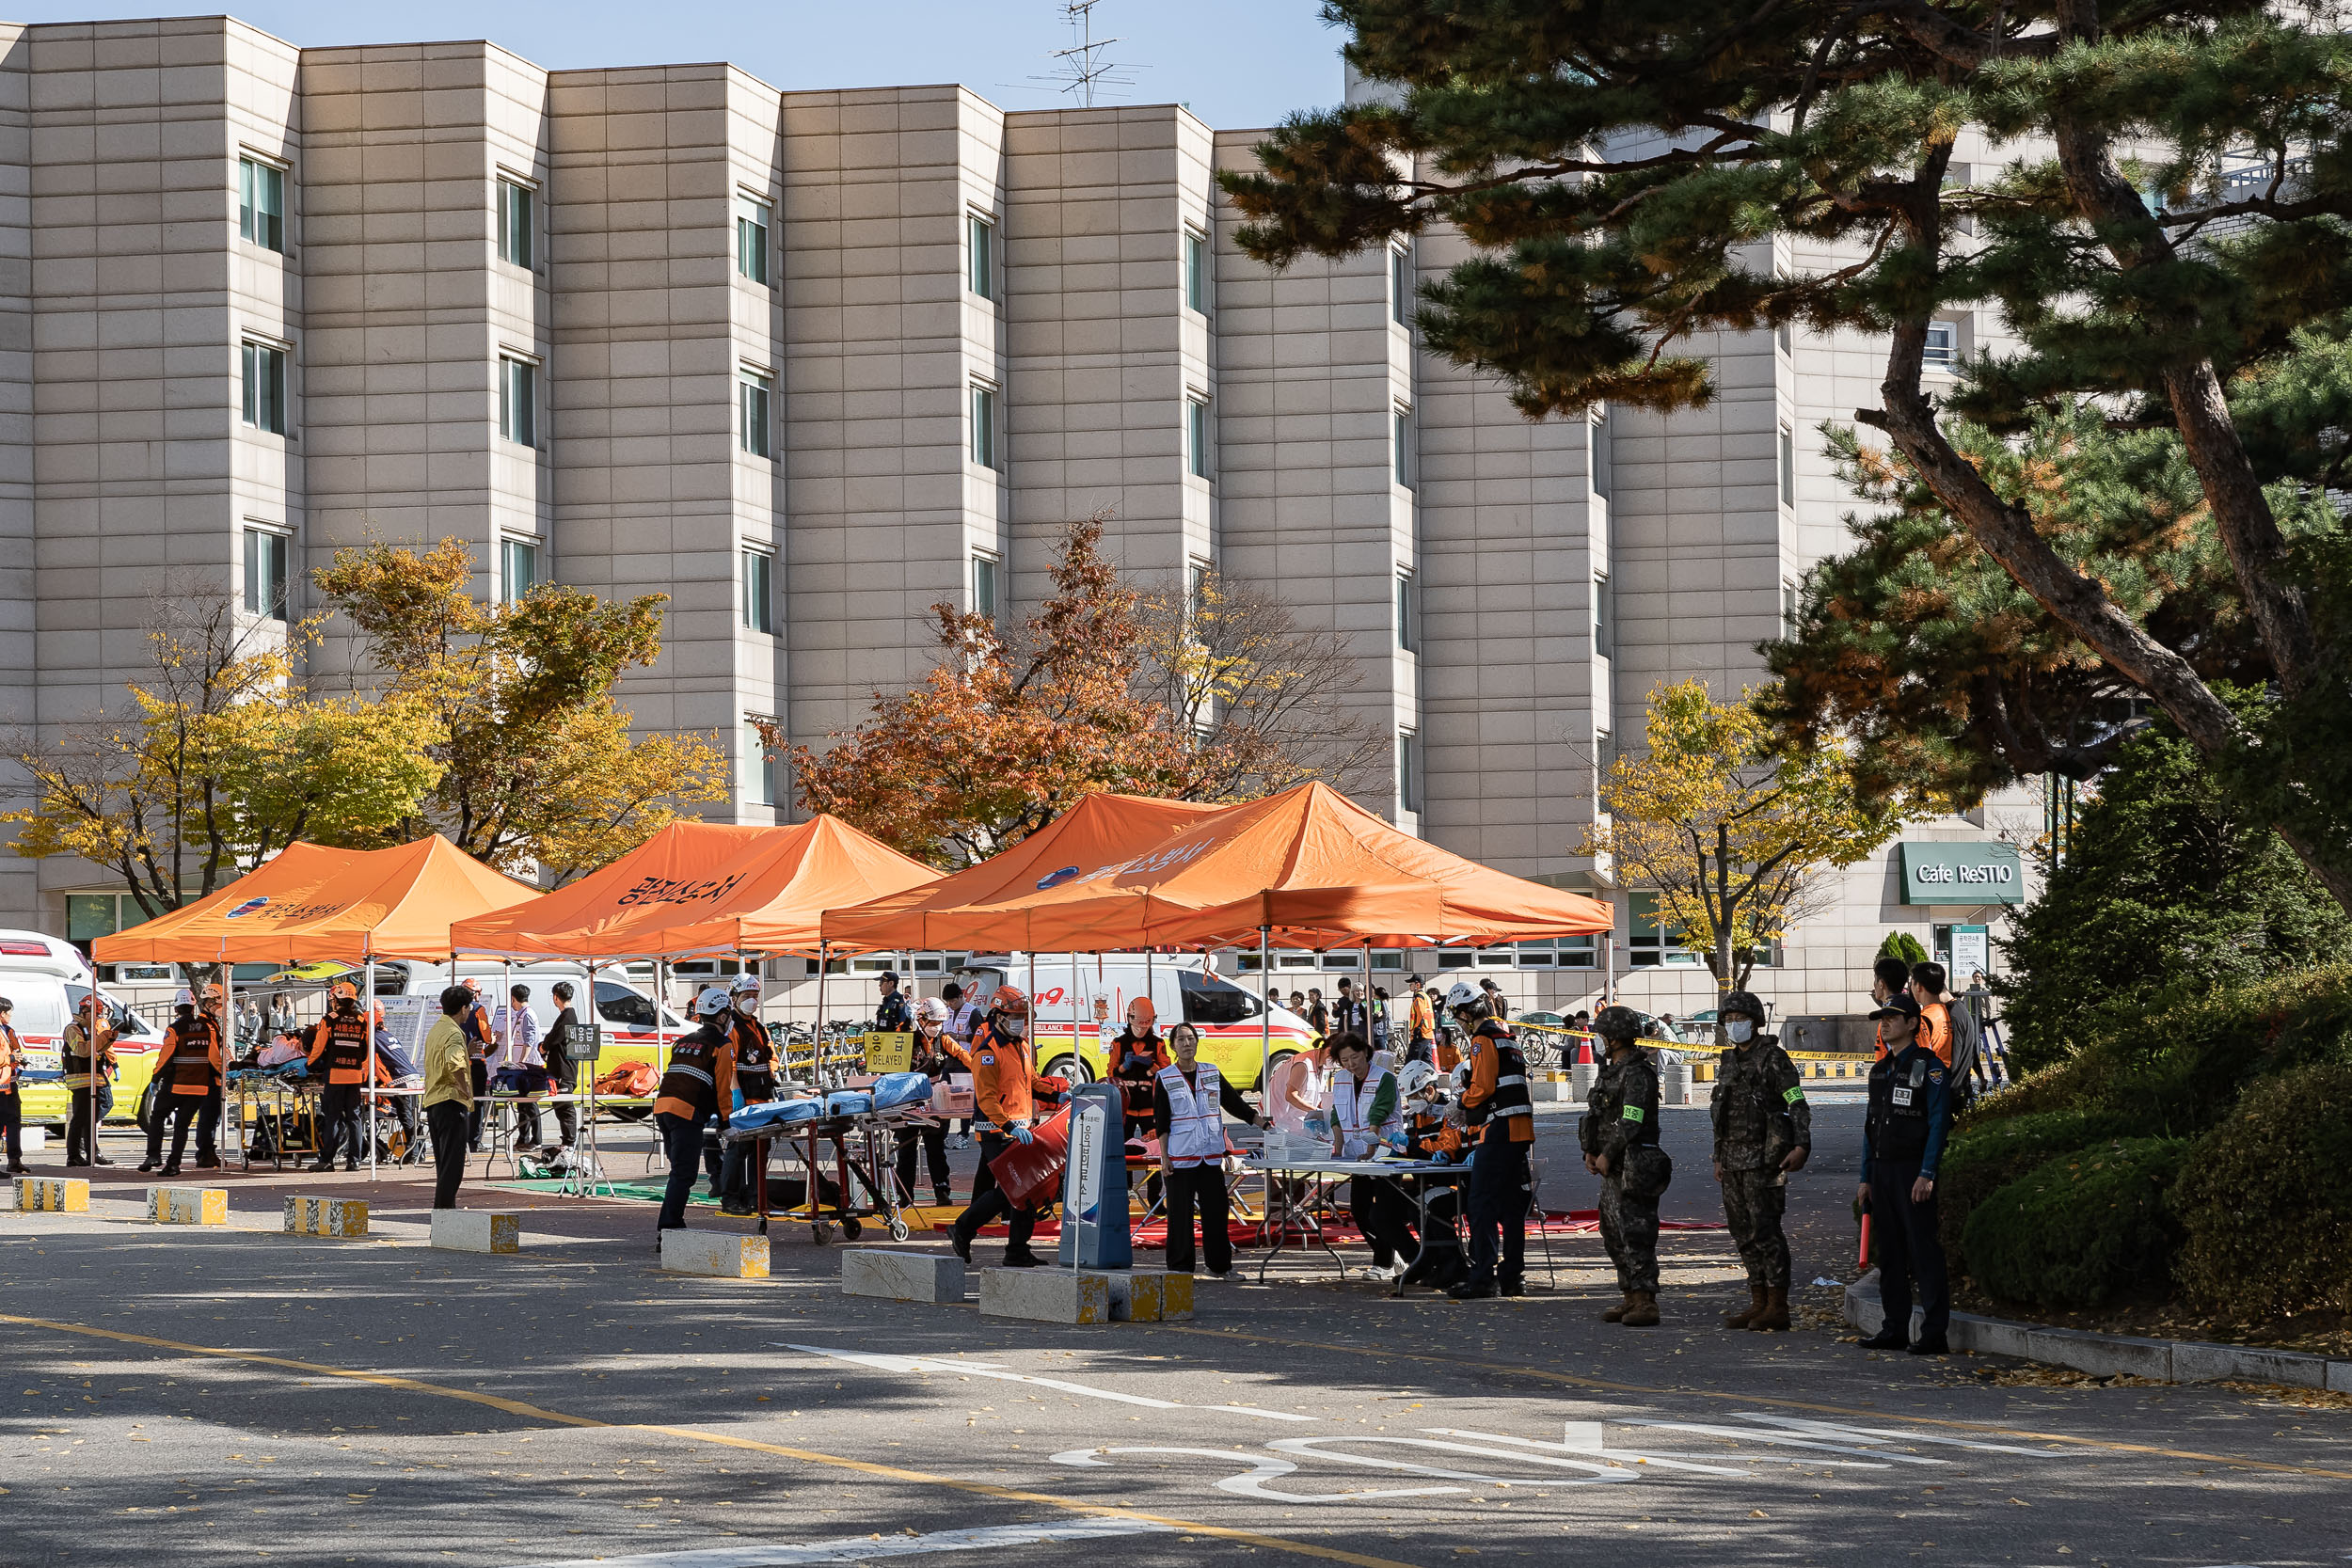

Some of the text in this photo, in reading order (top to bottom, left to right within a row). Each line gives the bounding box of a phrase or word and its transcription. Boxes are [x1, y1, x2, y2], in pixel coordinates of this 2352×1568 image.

[1917, 863, 2012, 883] Cafe ReSTIO
[1034, 988, 1064, 1006] 19
[570, 1027, 594, 1041] 비응급
[574, 1044, 590, 1053] MINOR
[873, 1054, 902, 1065] DELAYED
